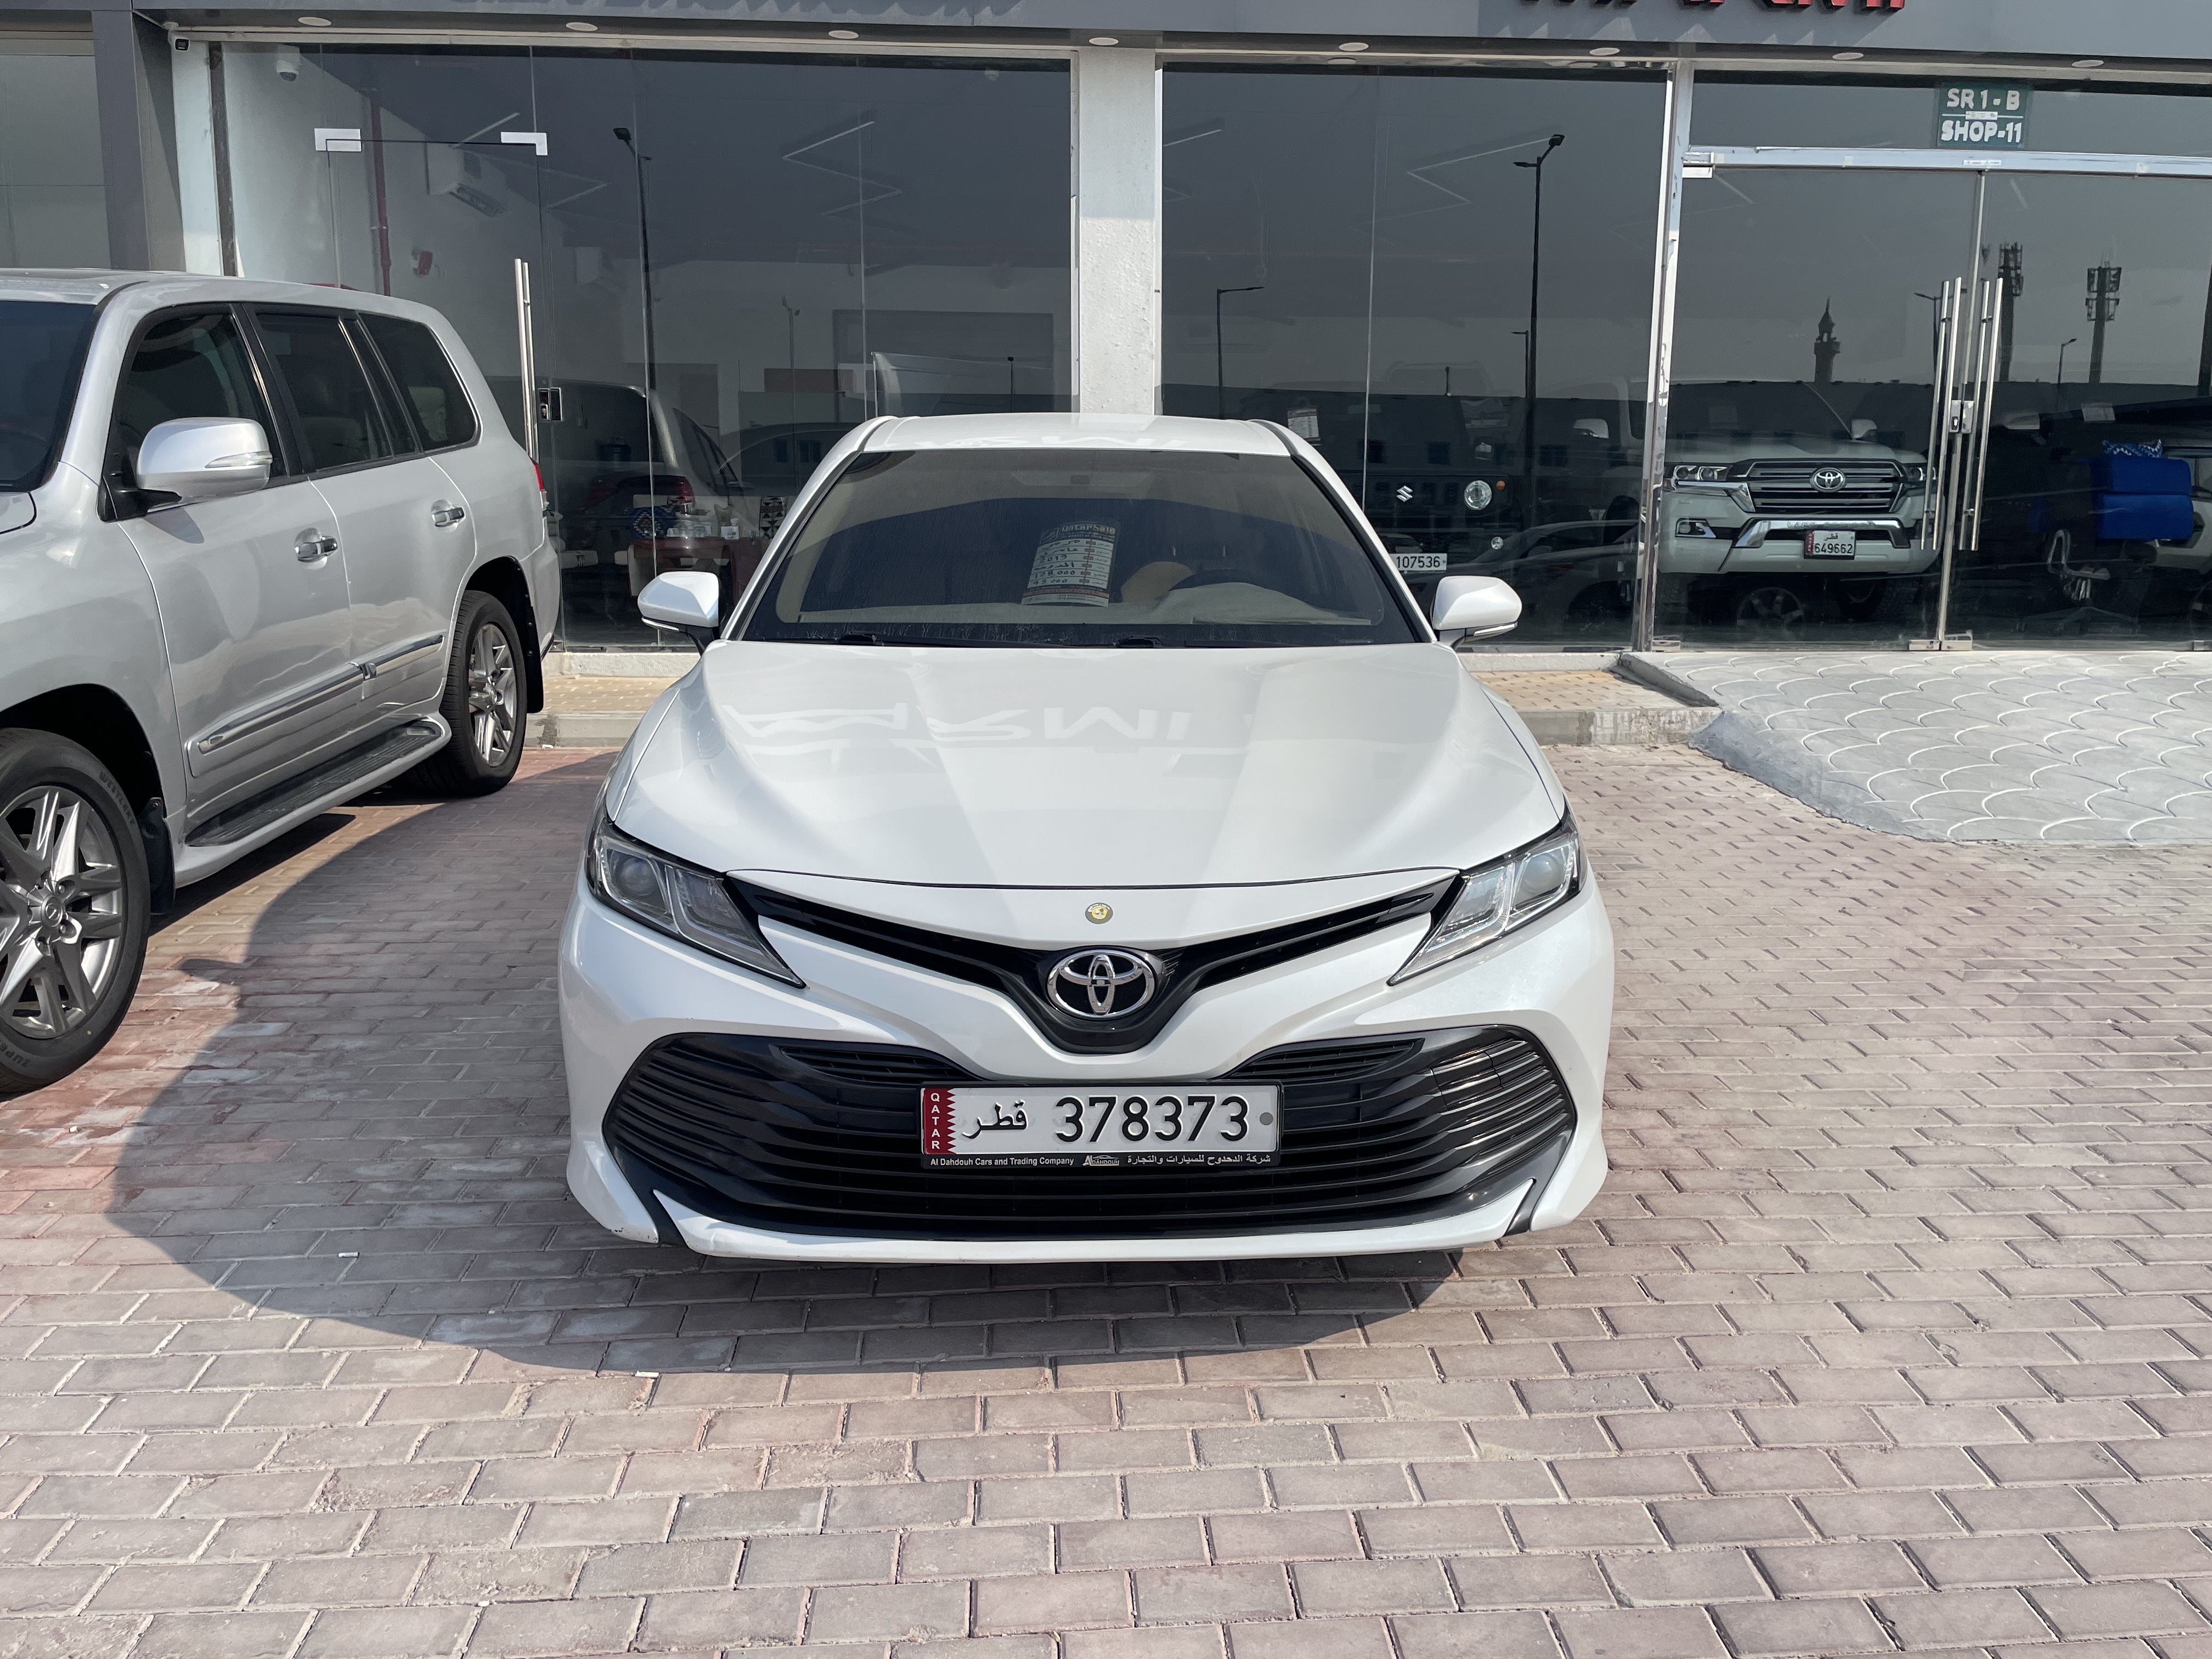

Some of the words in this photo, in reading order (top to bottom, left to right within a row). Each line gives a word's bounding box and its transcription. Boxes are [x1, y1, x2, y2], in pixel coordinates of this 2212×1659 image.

[1941, 120, 2022, 143] SHOP-11
[1814, 543, 1853, 554] 649662
[1396, 556, 1440, 569] 107536
[930, 1092, 940, 1150] QATAR
[962, 1099, 1028, 1139] قطر
[1055, 1094, 1250, 1143] 378373
[1010, 1158, 1037, 1166] Trading
[1040, 1157, 1074, 1166] Company
[1127, 1154, 1164, 1165] والتجارة
[1166, 1154, 1205, 1165] للسيارات
[1207, 1155, 1243, 1166] الدحدوح
[1246, 1153, 1271, 1166] شركة
